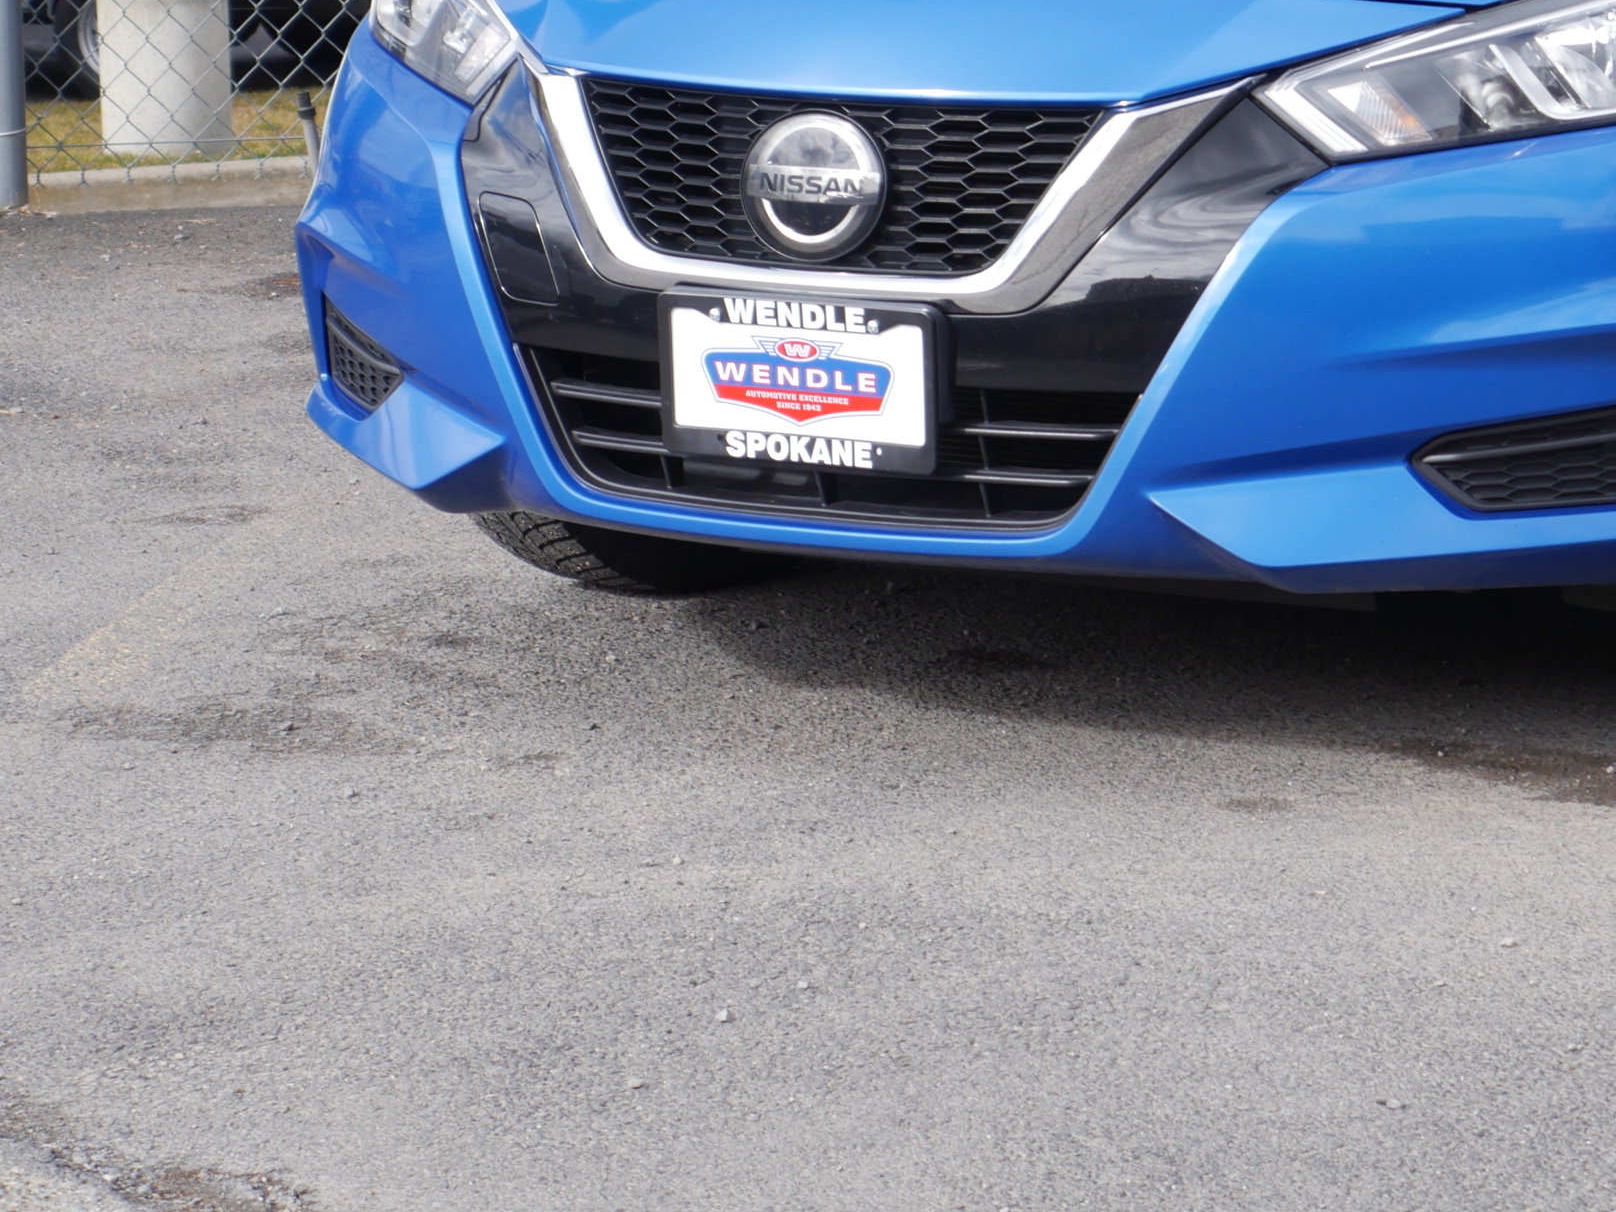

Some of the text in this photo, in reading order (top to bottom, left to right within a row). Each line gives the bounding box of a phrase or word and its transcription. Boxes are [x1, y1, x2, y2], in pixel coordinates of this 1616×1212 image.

[760, 172, 863, 197] NISSAN
[723, 298, 867, 334] WENDLE
[784, 343, 811, 358] W
[714, 361, 877, 394] WENDLE
[745, 390, 849, 405] AUTOMOTIVE EXCELLENCE
[776, 401, 822, 412] SINCE 1943
[725, 431, 873, 469] SPOKANE
